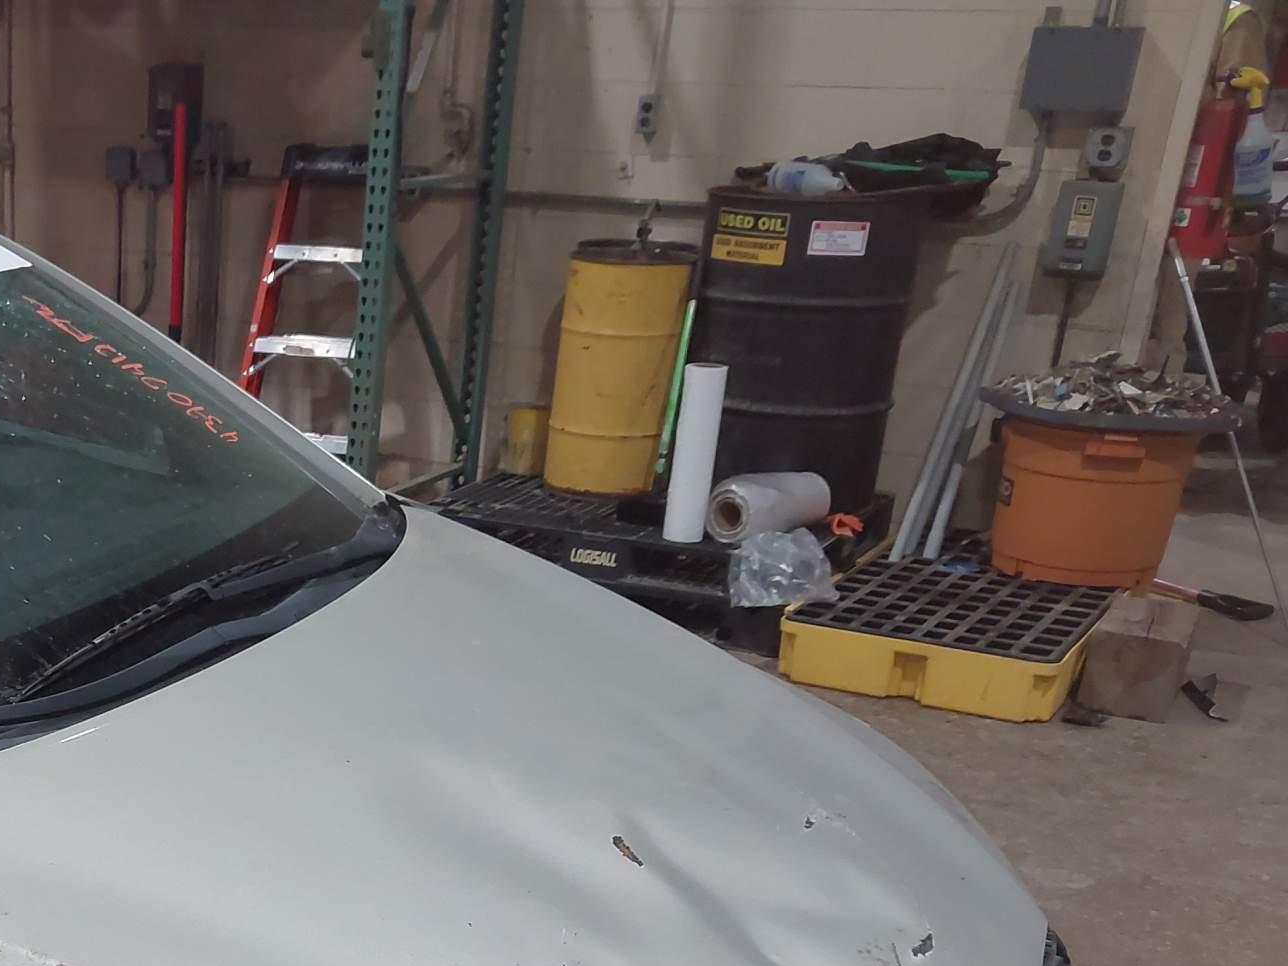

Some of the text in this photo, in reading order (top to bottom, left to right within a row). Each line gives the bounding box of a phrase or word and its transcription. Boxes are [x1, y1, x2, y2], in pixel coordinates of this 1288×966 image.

[720, 213, 785, 232] USED OIL
[570, 547, 617, 567] LOGISALL
